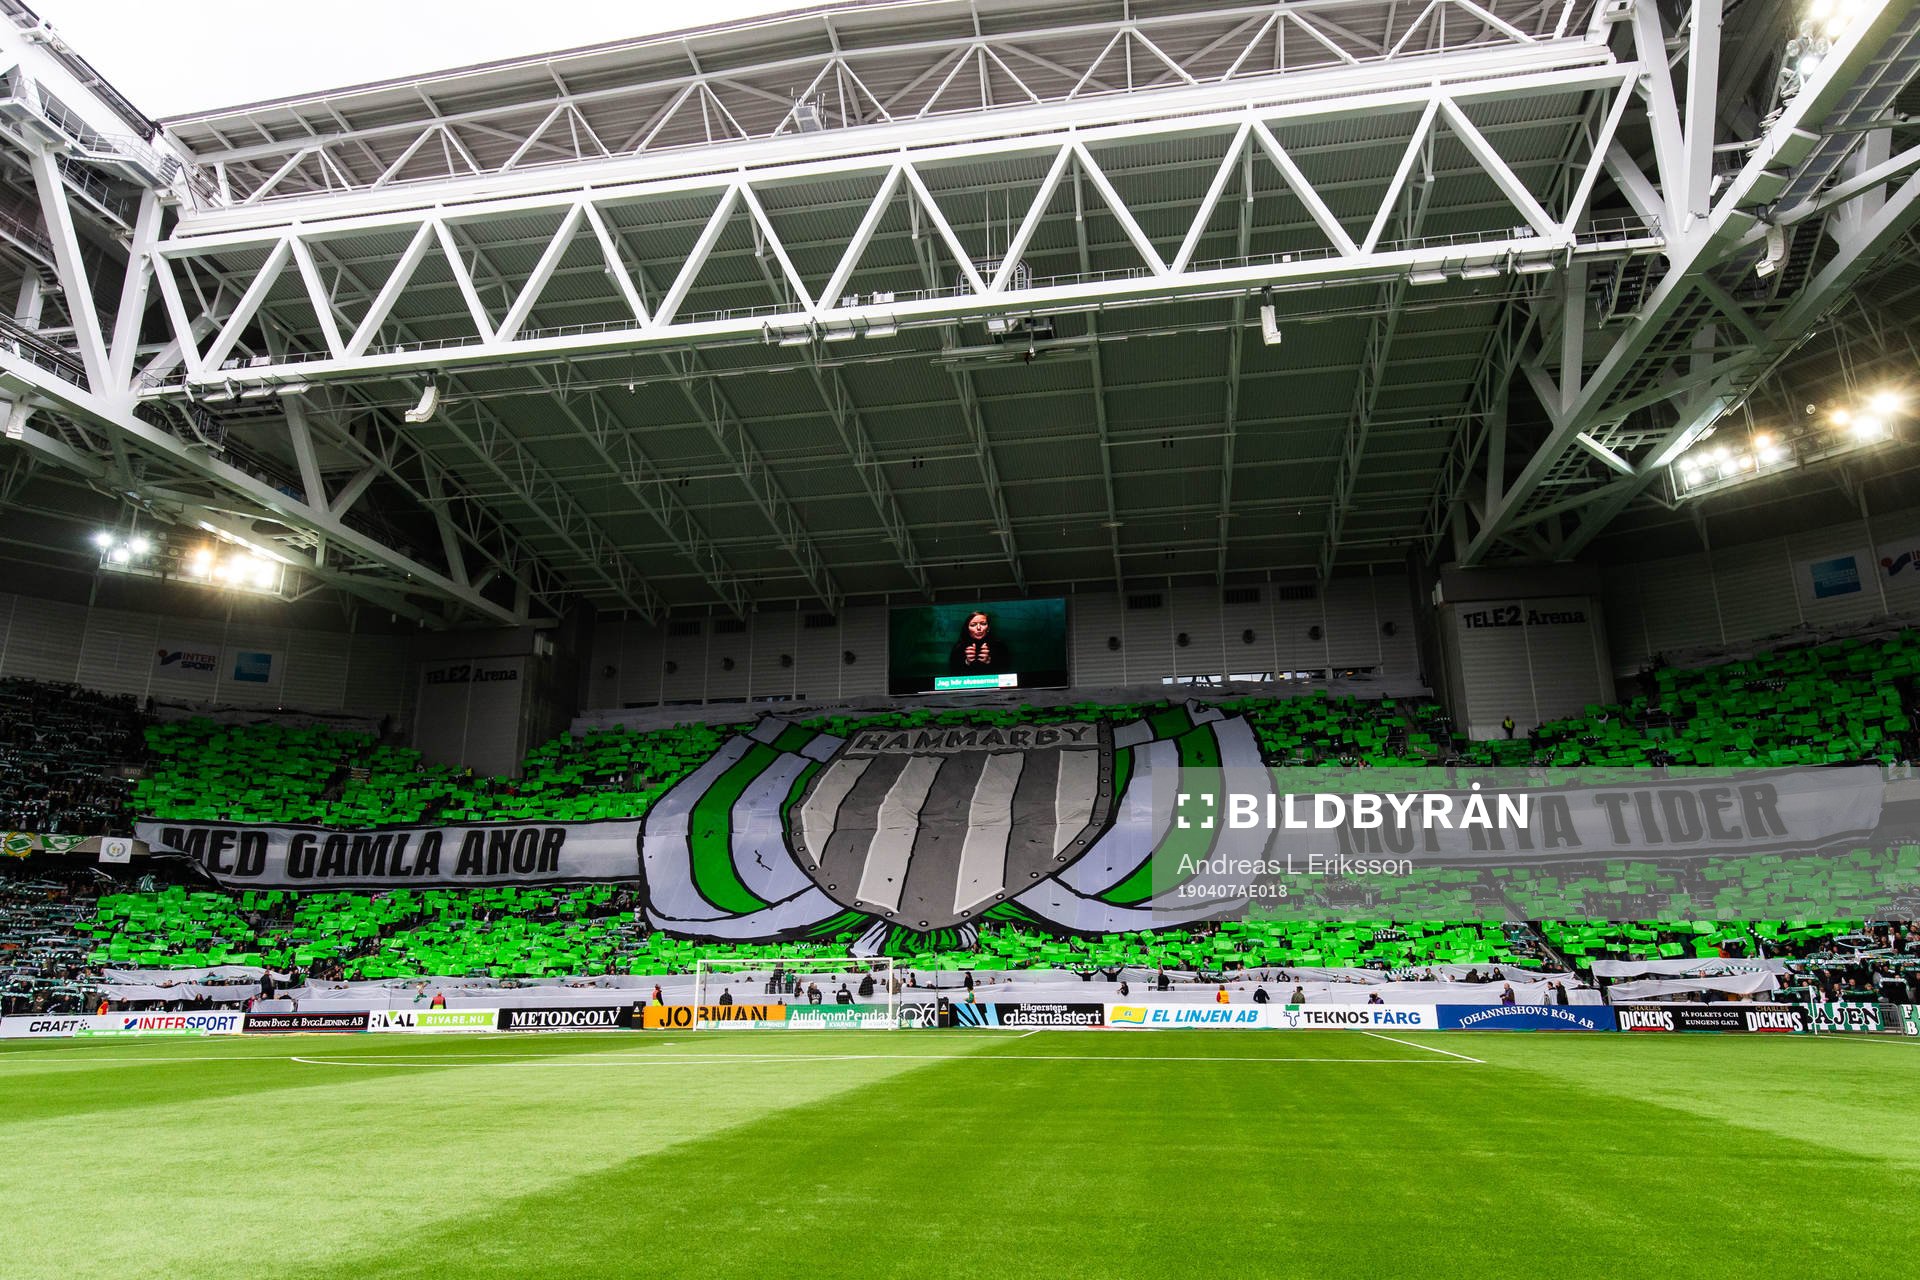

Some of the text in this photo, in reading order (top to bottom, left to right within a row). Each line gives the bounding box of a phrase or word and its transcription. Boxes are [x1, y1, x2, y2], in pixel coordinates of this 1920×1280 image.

[1464, 606, 1586, 628] TELE2 Arena
[183, 652, 216, 663] INTER
[181, 661, 215, 671] SPORT
[473, 668, 517, 682] Arena
[855, 726, 1090, 750] HAMMARBY
[1595, 783, 1788, 844] TIDER
[287, 832, 440, 878] GAMLA
[454, 828, 568, 876] ANOR
[1020, 1003, 1067, 1013] Hägerstens
[139, 1016, 237, 1031] INTERSPORT
[350, 1017, 364, 1026] AB
[426, 1015, 485, 1025] RIVARE.NU
[511, 1011, 619, 1026] METODGOLV
[1003, 1008, 1101, 1026] glasmästeri
[1152, 1010, 1258, 1022] EL LINJEN AB
[1304, 1009, 1421, 1024] TEKNOS FÄRG
[1459, 1006, 1594, 1029] JOHANNESHOVS RÖR AB
[1619, 1011, 1674, 1031] DICKENS
[1746, 1012, 1803, 1032] DICKENS
[29, 1021, 78, 1032] CRAFT
